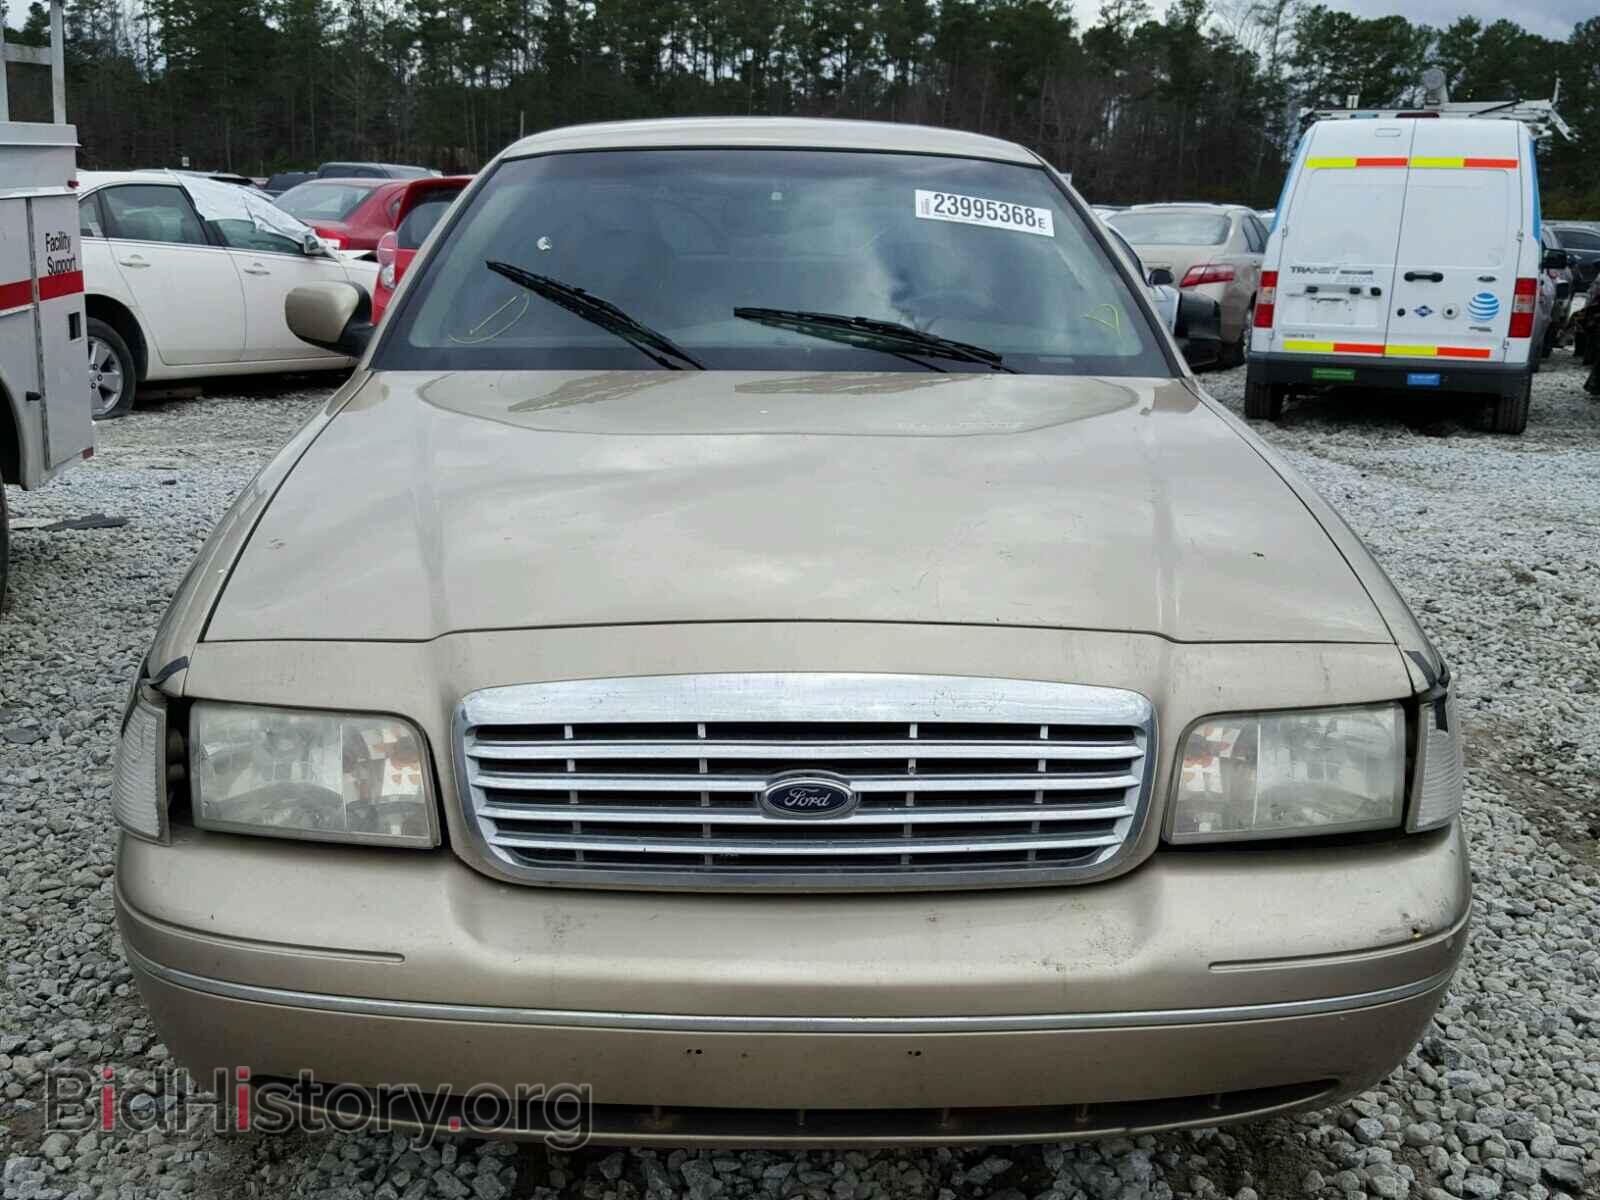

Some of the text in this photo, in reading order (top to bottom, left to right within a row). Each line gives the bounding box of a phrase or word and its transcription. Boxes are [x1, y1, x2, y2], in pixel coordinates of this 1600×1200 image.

[45, 231, 71, 253] Facility
[47, 254, 76, 276] Support
[784, 787, 831, 807] Ford
